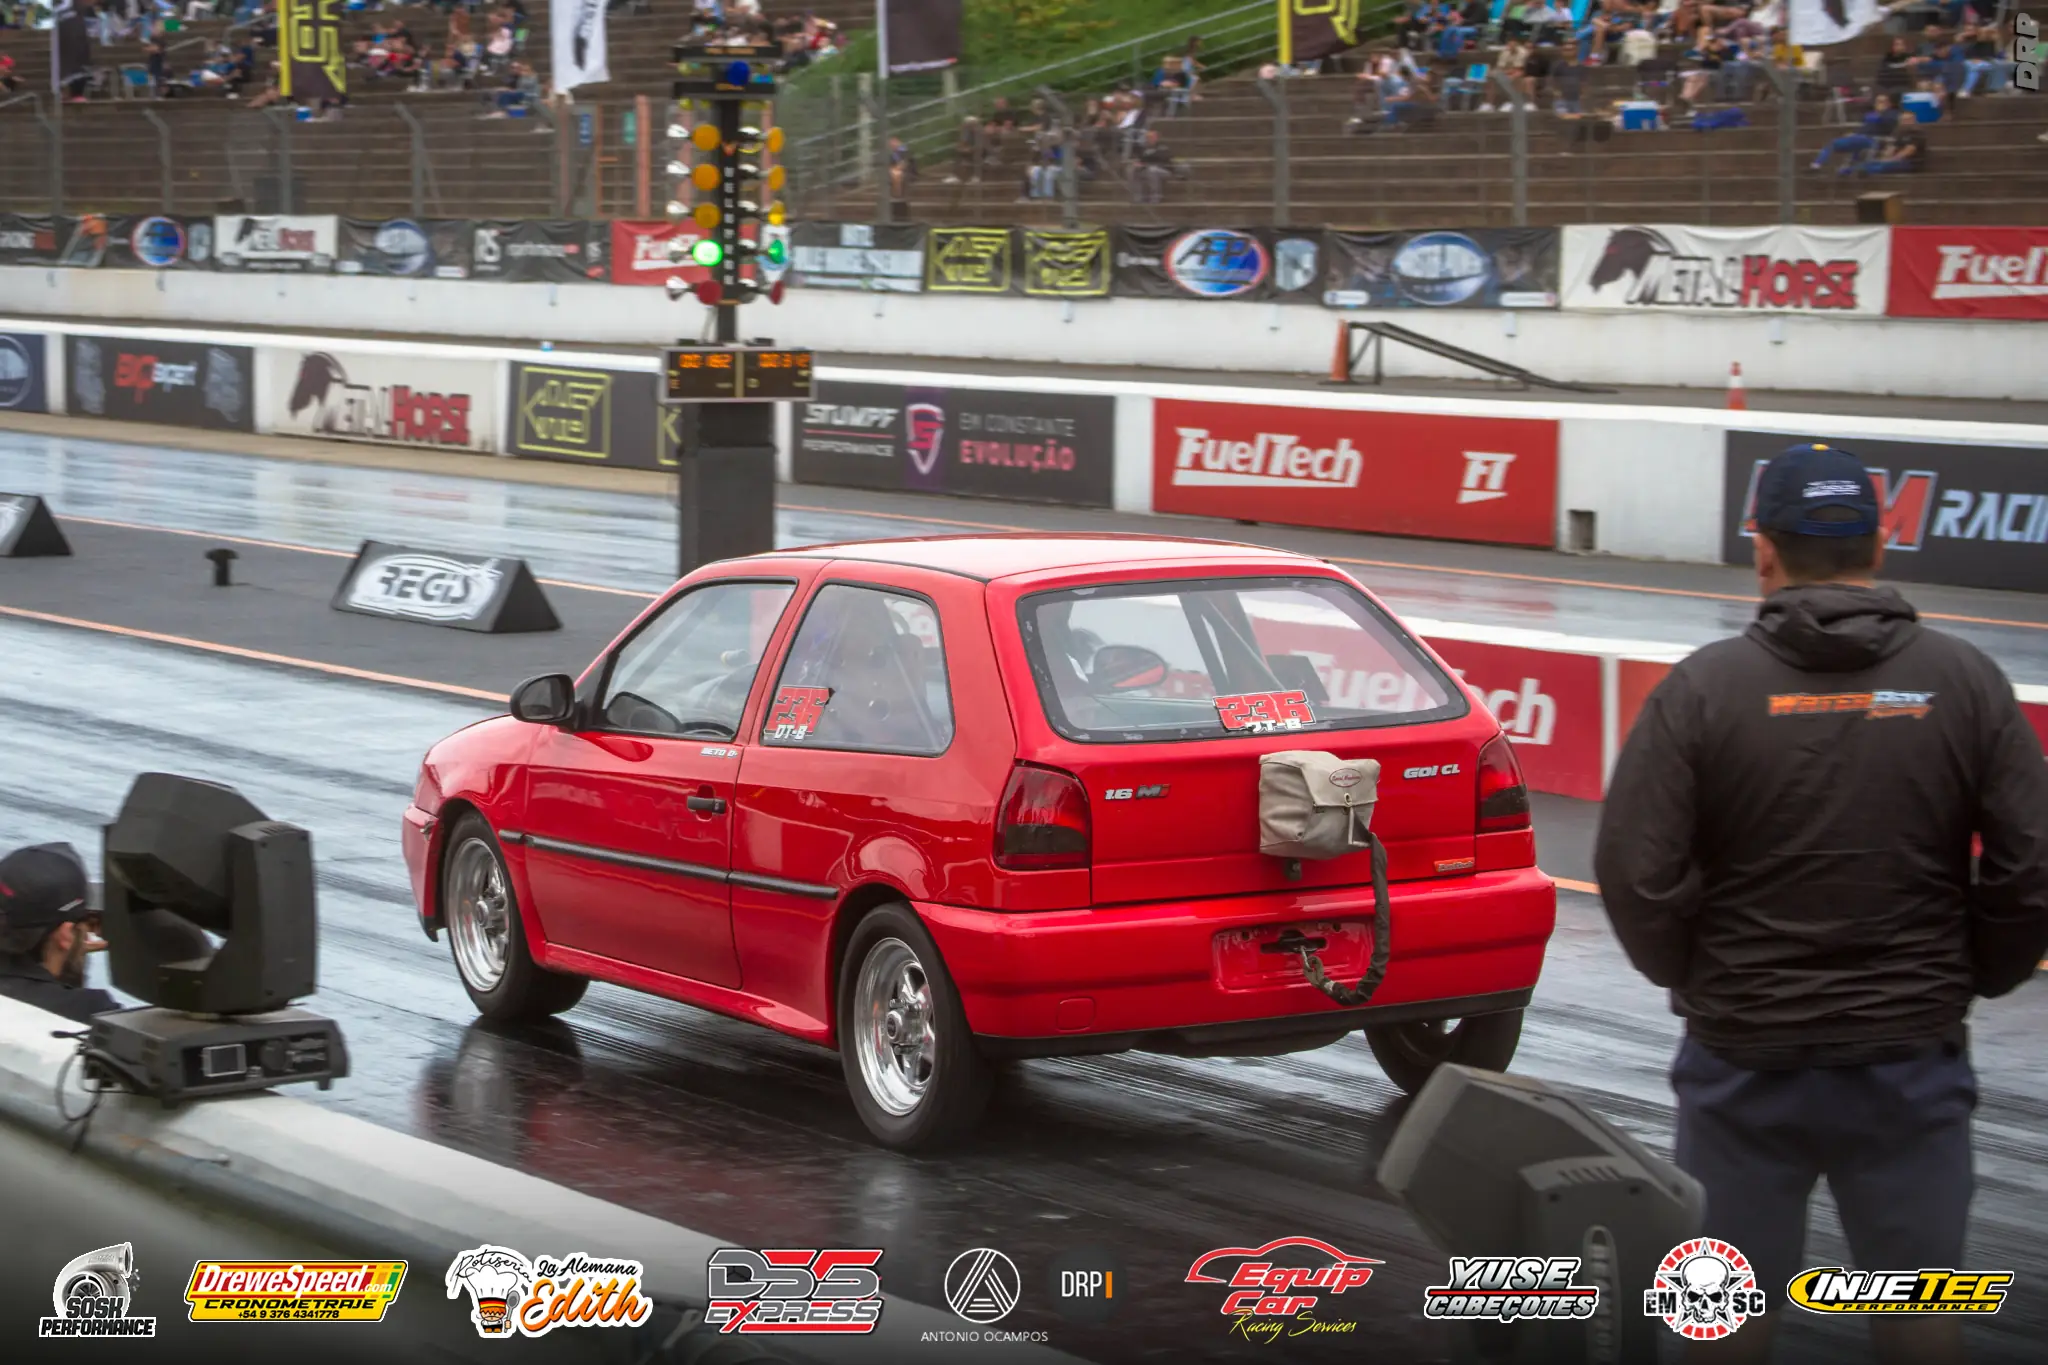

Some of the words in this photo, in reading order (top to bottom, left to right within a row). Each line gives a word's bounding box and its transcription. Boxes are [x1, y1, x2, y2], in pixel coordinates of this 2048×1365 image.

[959, 438, 1077, 473] EVOLUÇÃO
[1173, 427, 1363, 488] FuelTech
[1931, 489, 2048, 543] RACI
[764, 685, 831, 733] 236
[1212, 690, 1316, 731] 236
[1441, 764, 1460, 775] CL
